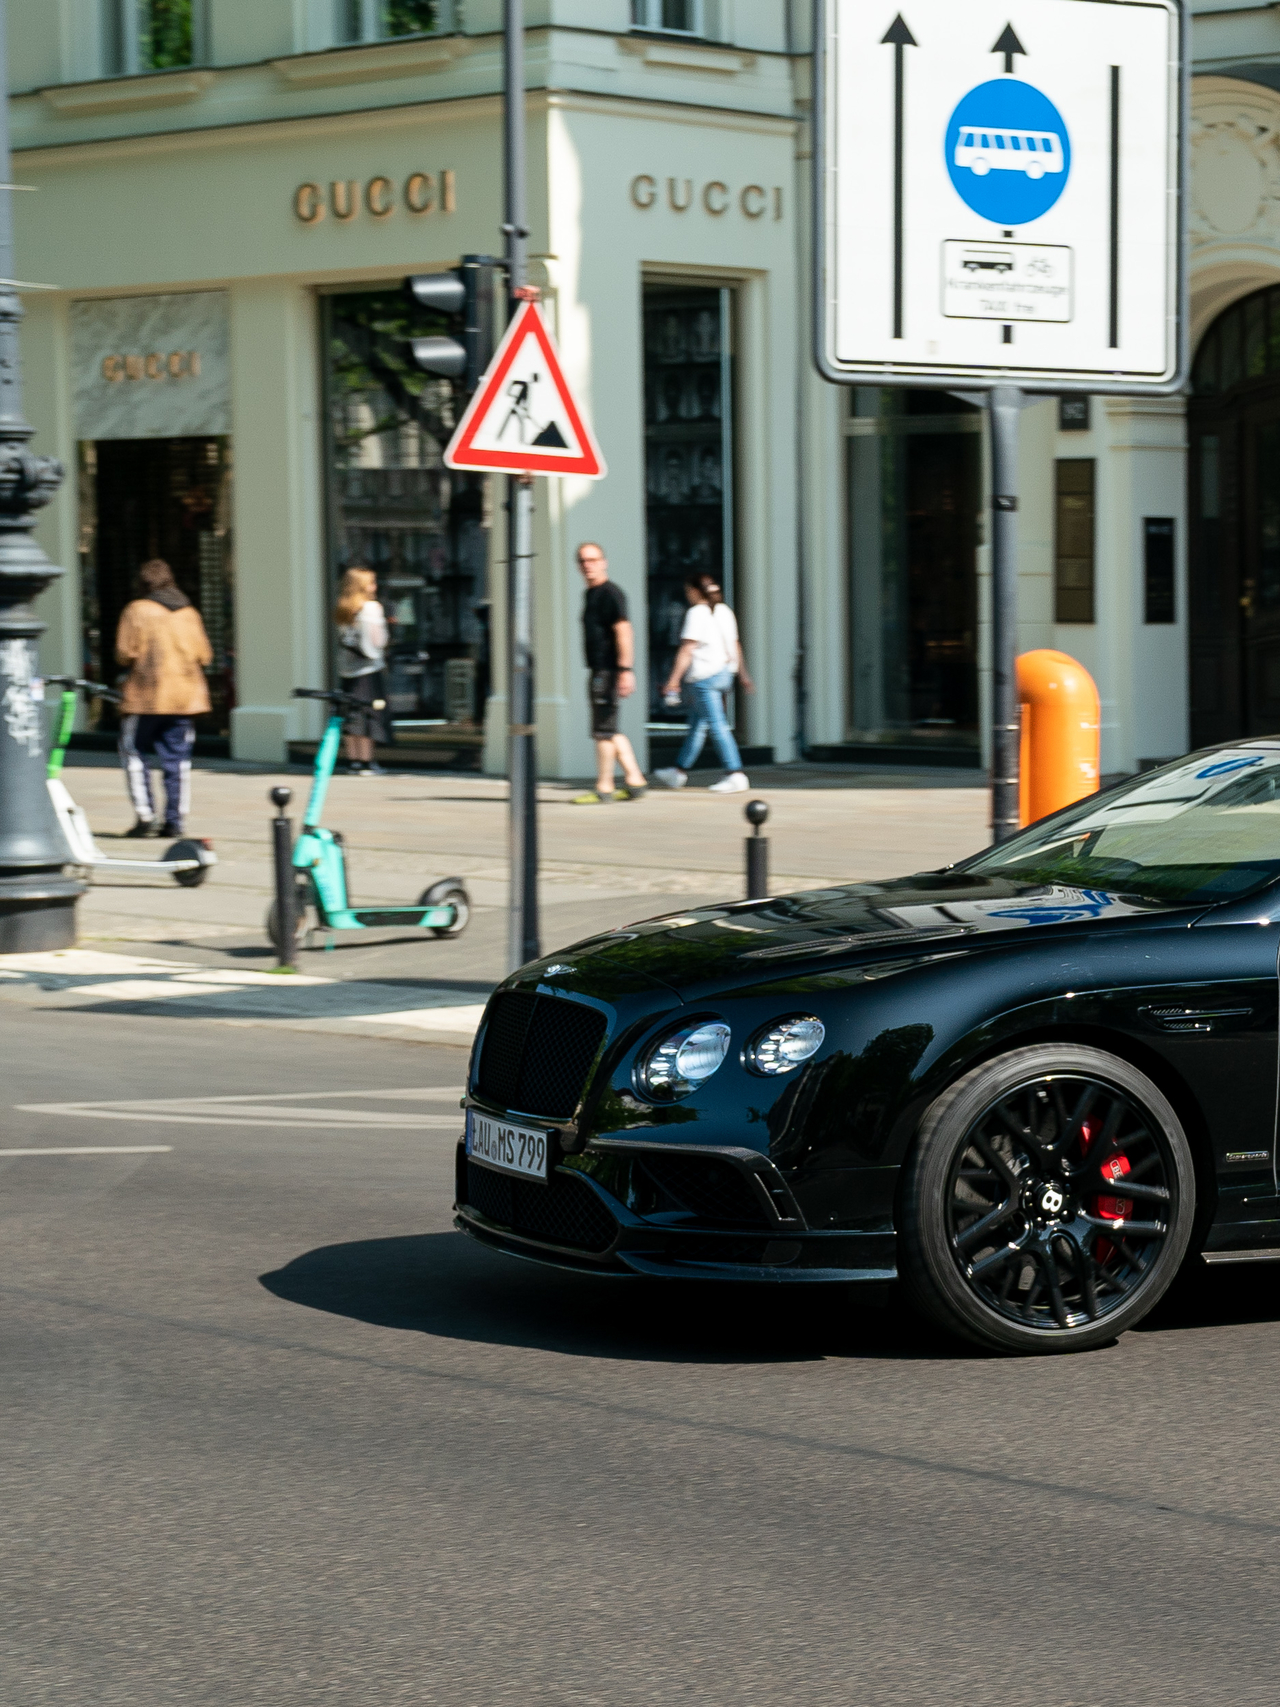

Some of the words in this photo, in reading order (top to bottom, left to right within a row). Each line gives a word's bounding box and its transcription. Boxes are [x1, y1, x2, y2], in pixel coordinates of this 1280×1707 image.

[293, 170, 455, 224] GUCCI
[629, 174, 783, 222] GUCCI
[102, 351, 201, 382] GUCCI
[498, 1127, 515, 1165] MS
[518, 1132, 545, 1171] 799
